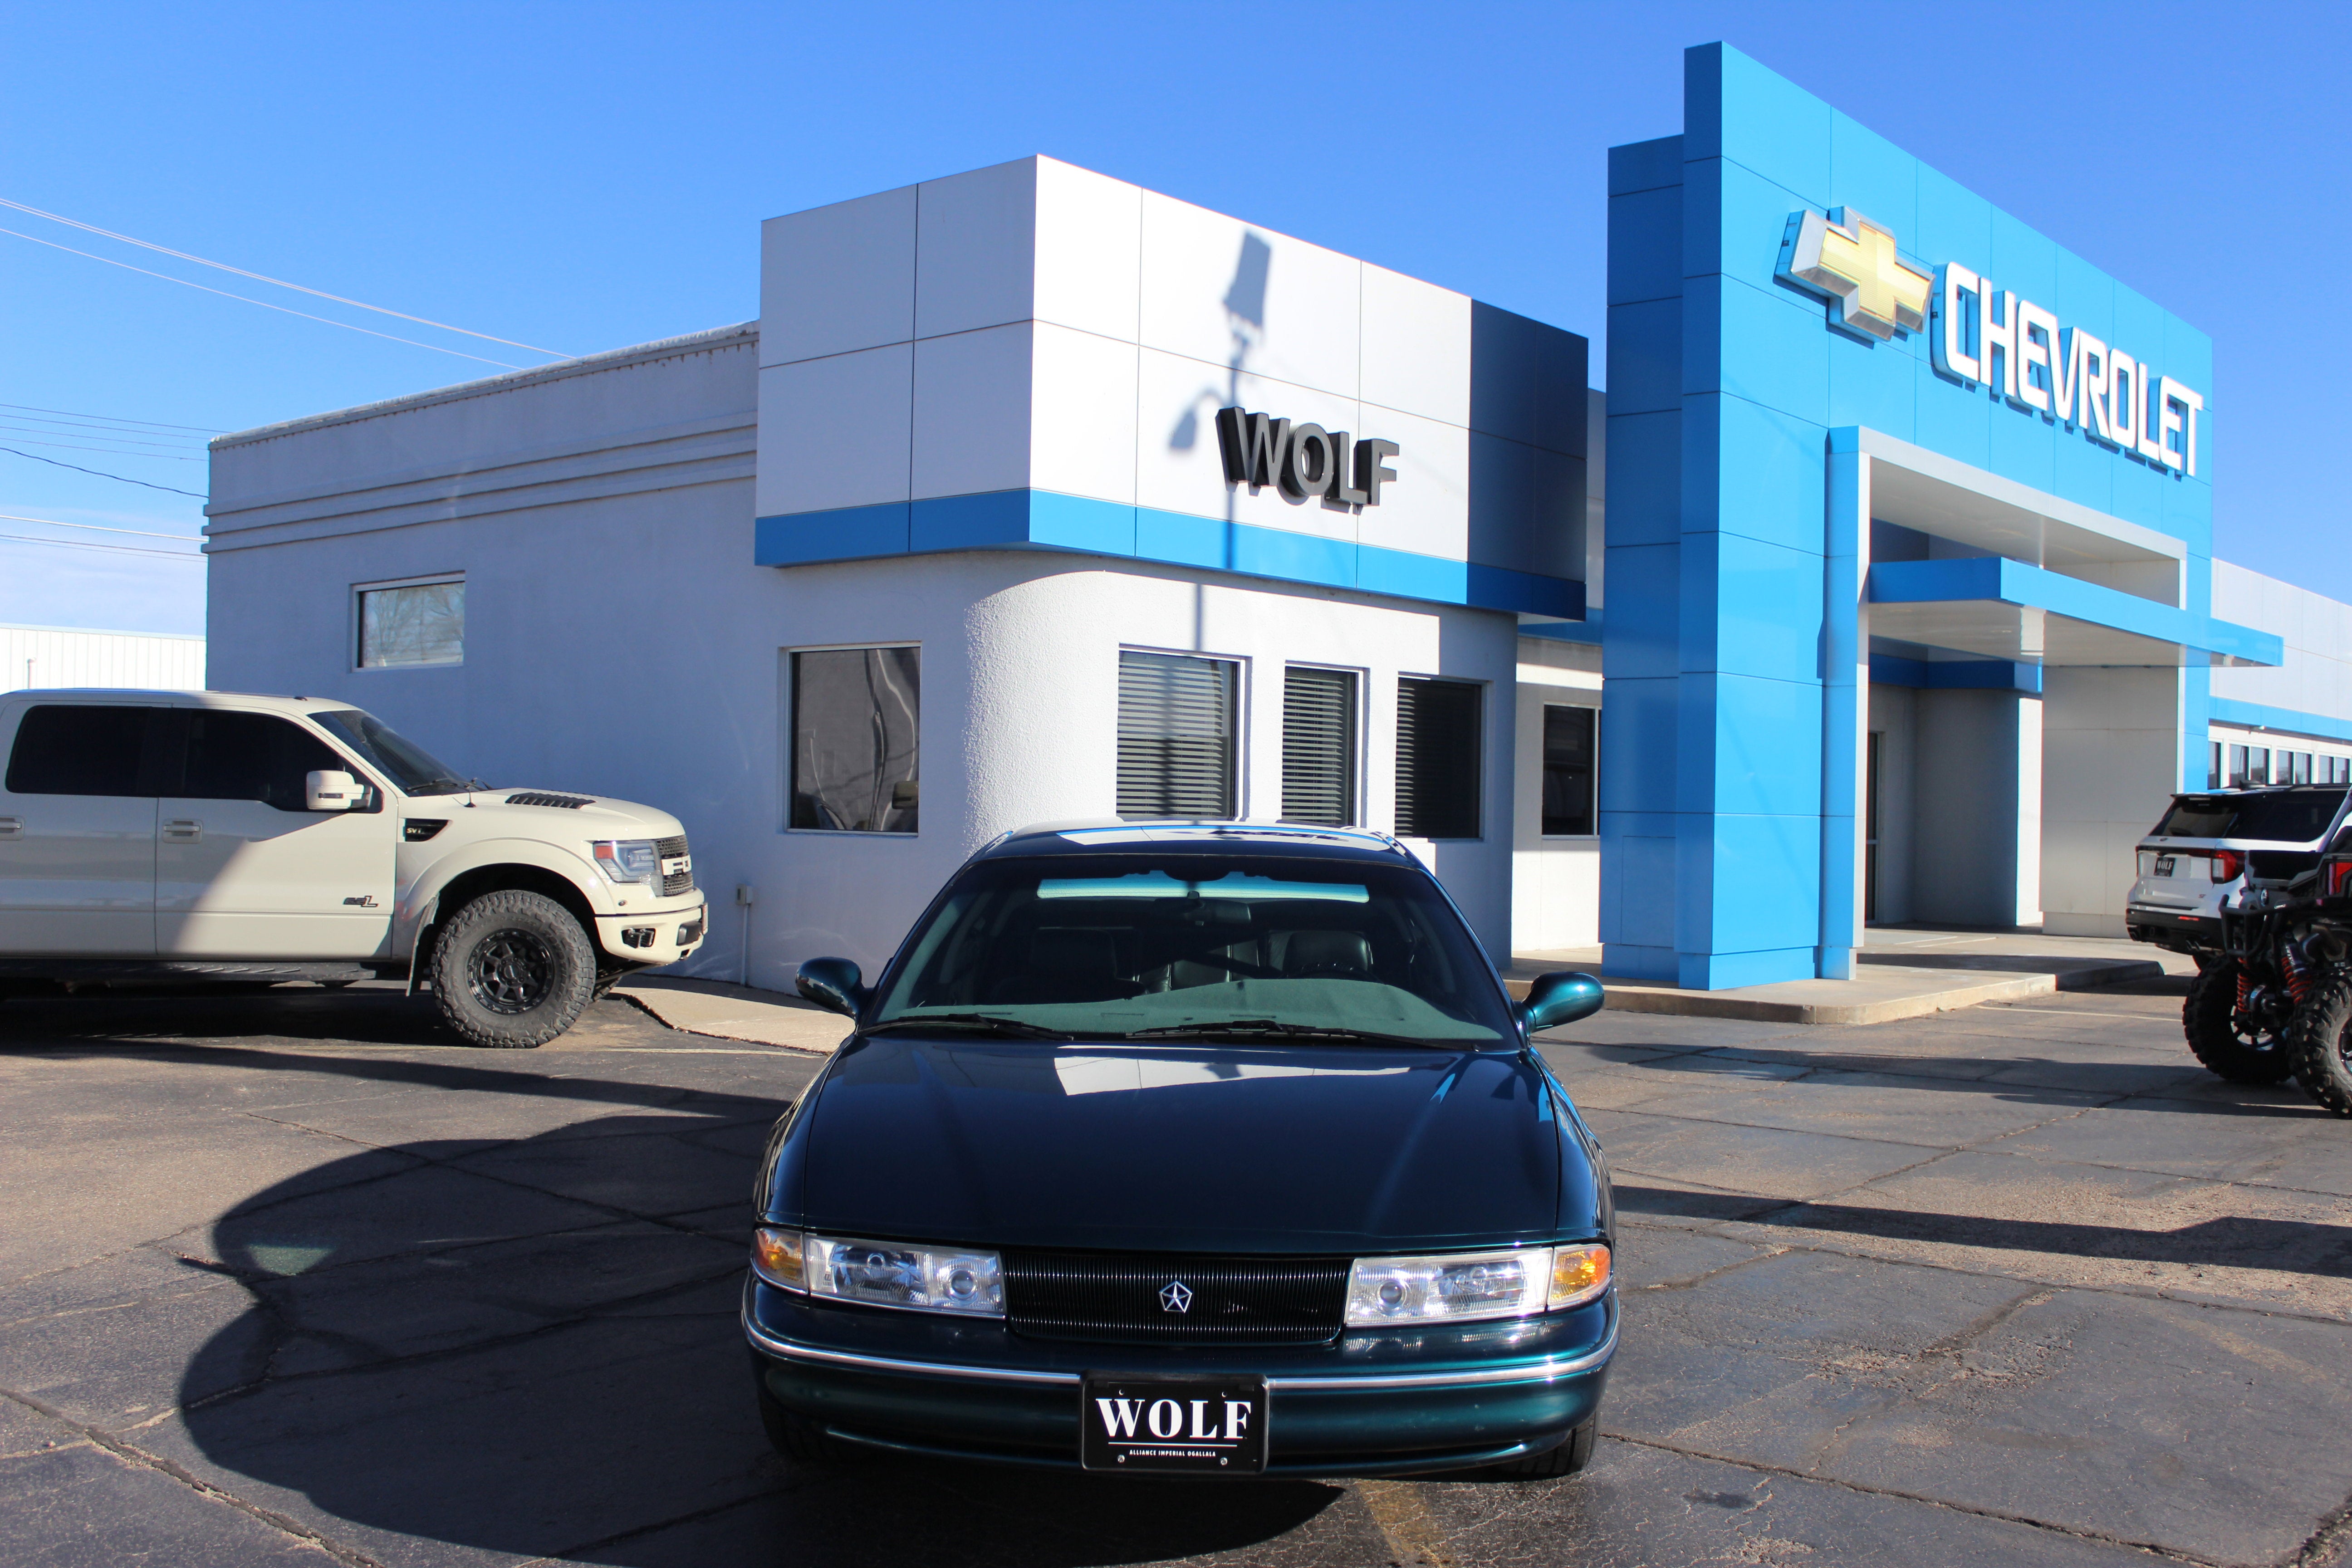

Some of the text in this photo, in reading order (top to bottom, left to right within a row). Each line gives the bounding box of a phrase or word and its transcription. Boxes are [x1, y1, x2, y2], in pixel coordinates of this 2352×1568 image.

[1944, 261, 2203, 477] CHEVROLET
[1216, 407, 1399, 506] WOLF
[2157, 860, 2173, 870] WOLF
[1095, 1398, 1251, 1439] WOLF
